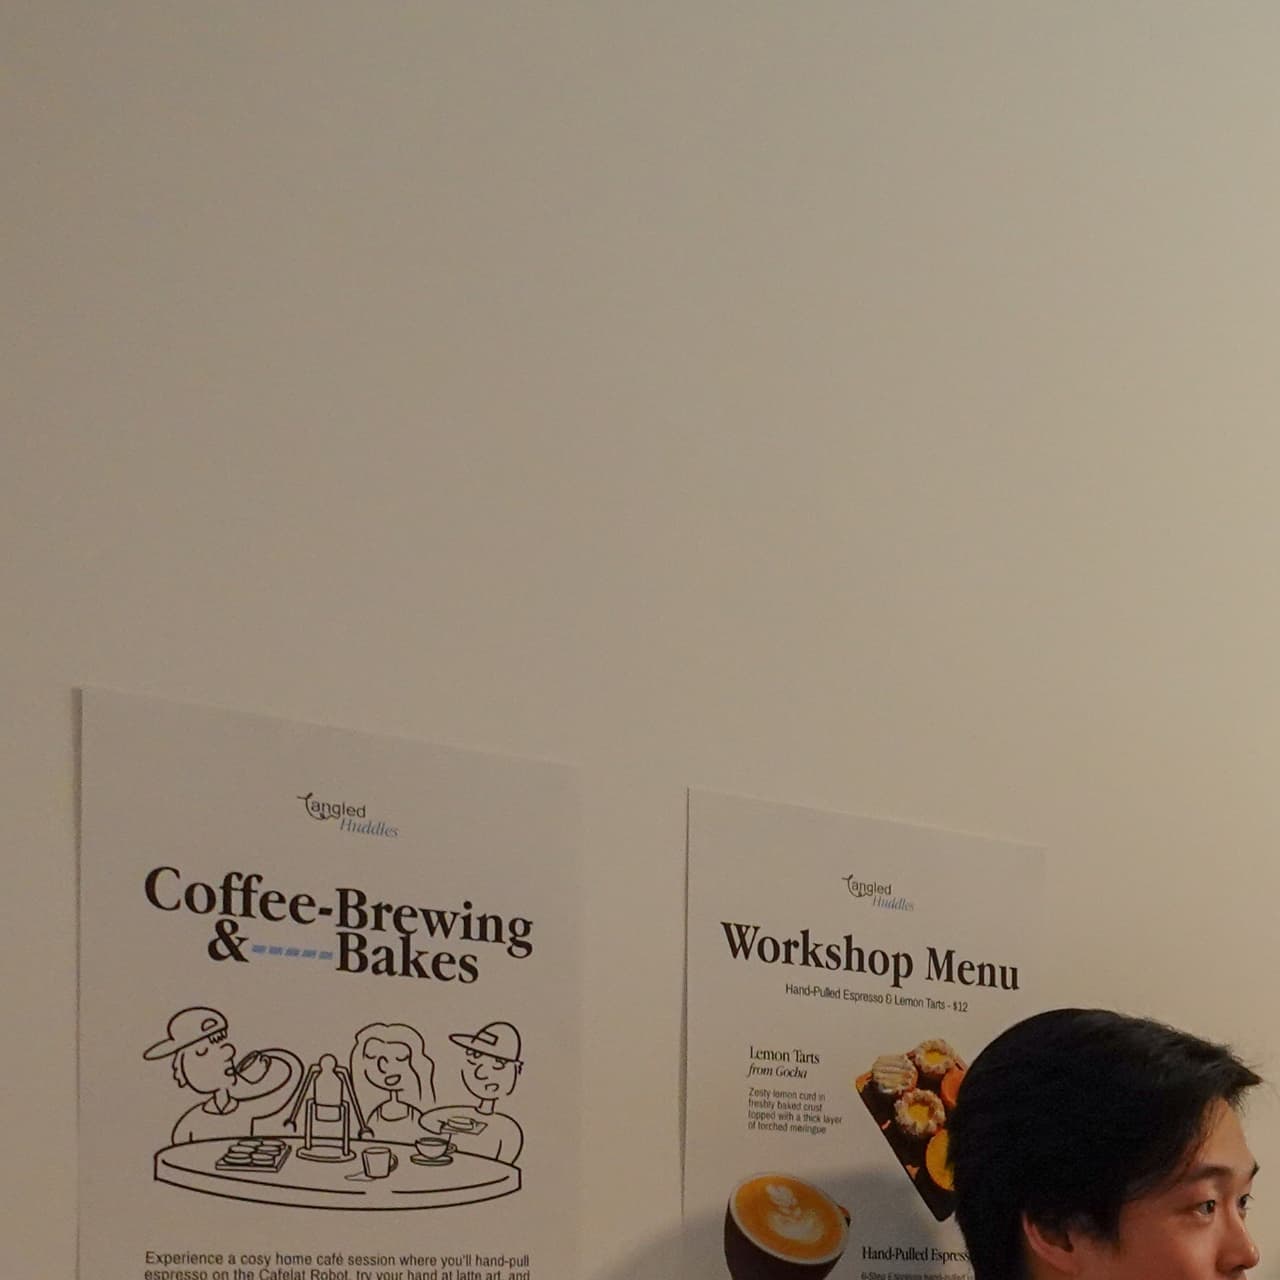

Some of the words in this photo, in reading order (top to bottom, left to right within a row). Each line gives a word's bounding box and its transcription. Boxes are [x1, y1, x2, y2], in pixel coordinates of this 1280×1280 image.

[297, 792, 366, 821] Tangled
[340, 819, 398, 837] Huddles
[841, 874, 892, 897] Tangled
[144, 866, 533, 958] Coffee-Brewing
[207, 919, 251, 963] &
[337, 932, 479, 984] Bakes
[720, 921, 914, 988] Workshop
[925, 947, 1020, 990] Menu
[785, 984, 841, 1000] Hand-Pulled
[843, 989, 884, 1005] Espresso
[894, 994, 924, 1008] Lemon
[926, 998, 945, 1010] Tarts
[953, 1001, 969, 1013] $12
[750, 1046, 790, 1062] Lemon
[793, 1049, 820, 1064] Tarts
[747, 1063, 773, 1078] from
[145, 1251, 224, 1267] Experience
[228, 1254, 236, 1265] a
[240, 1255, 271, 1267] cosy
[276, 1252, 312, 1266] home
[348, 1253, 396, 1267] session
[400, 1253, 438, 1267] where
[441, 1254, 472, 1270] you'll
[476, 1254, 530, 1269] hand-pull
[862, 1246, 929, 1261] Hand-Pulled
[931, 1248, 970, 1265] Espress
